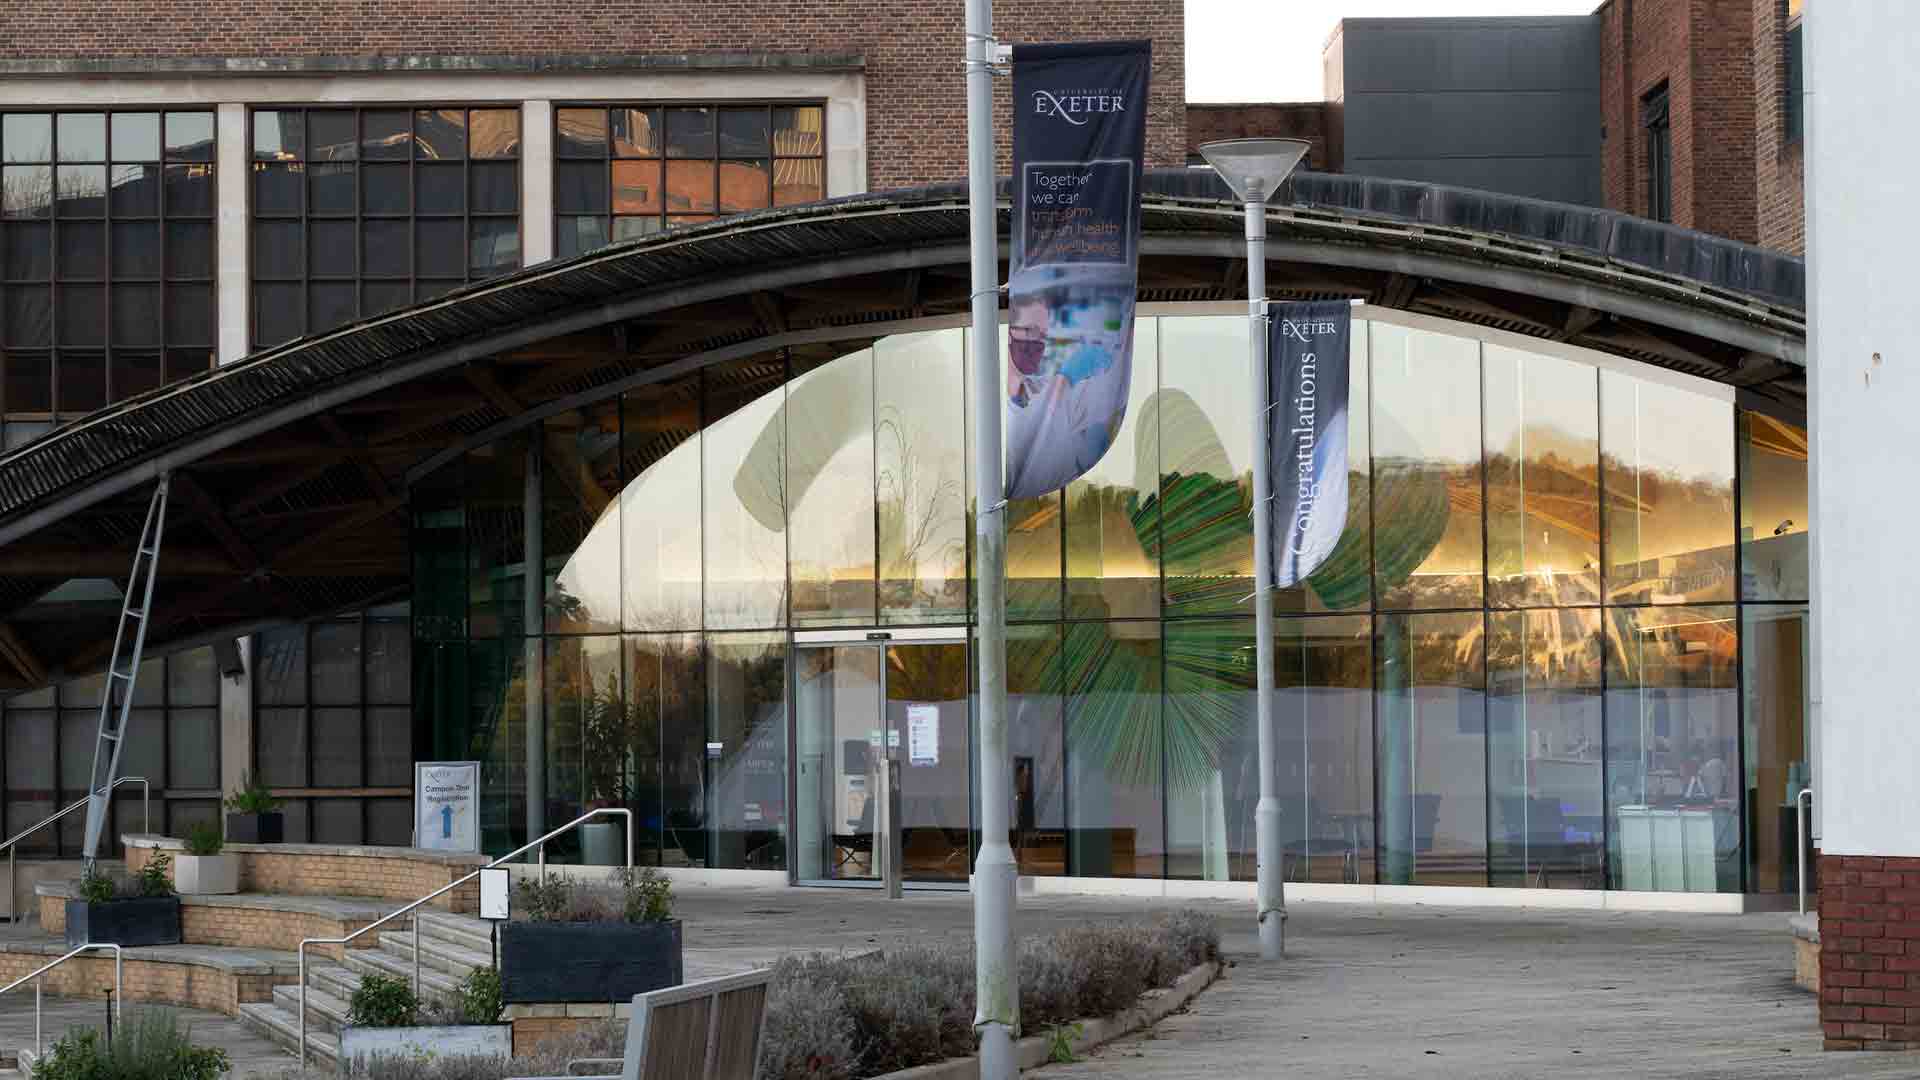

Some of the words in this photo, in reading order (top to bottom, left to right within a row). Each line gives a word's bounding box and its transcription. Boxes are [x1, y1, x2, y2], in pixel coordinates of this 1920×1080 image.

[1032, 90, 1125, 125] EXETER
[1032, 171, 1092, 190] Together
[1032, 193, 1053, 204] we
[1058, 193, 1080, 204] can
[1282, 319, 1336, 342] EXETER
